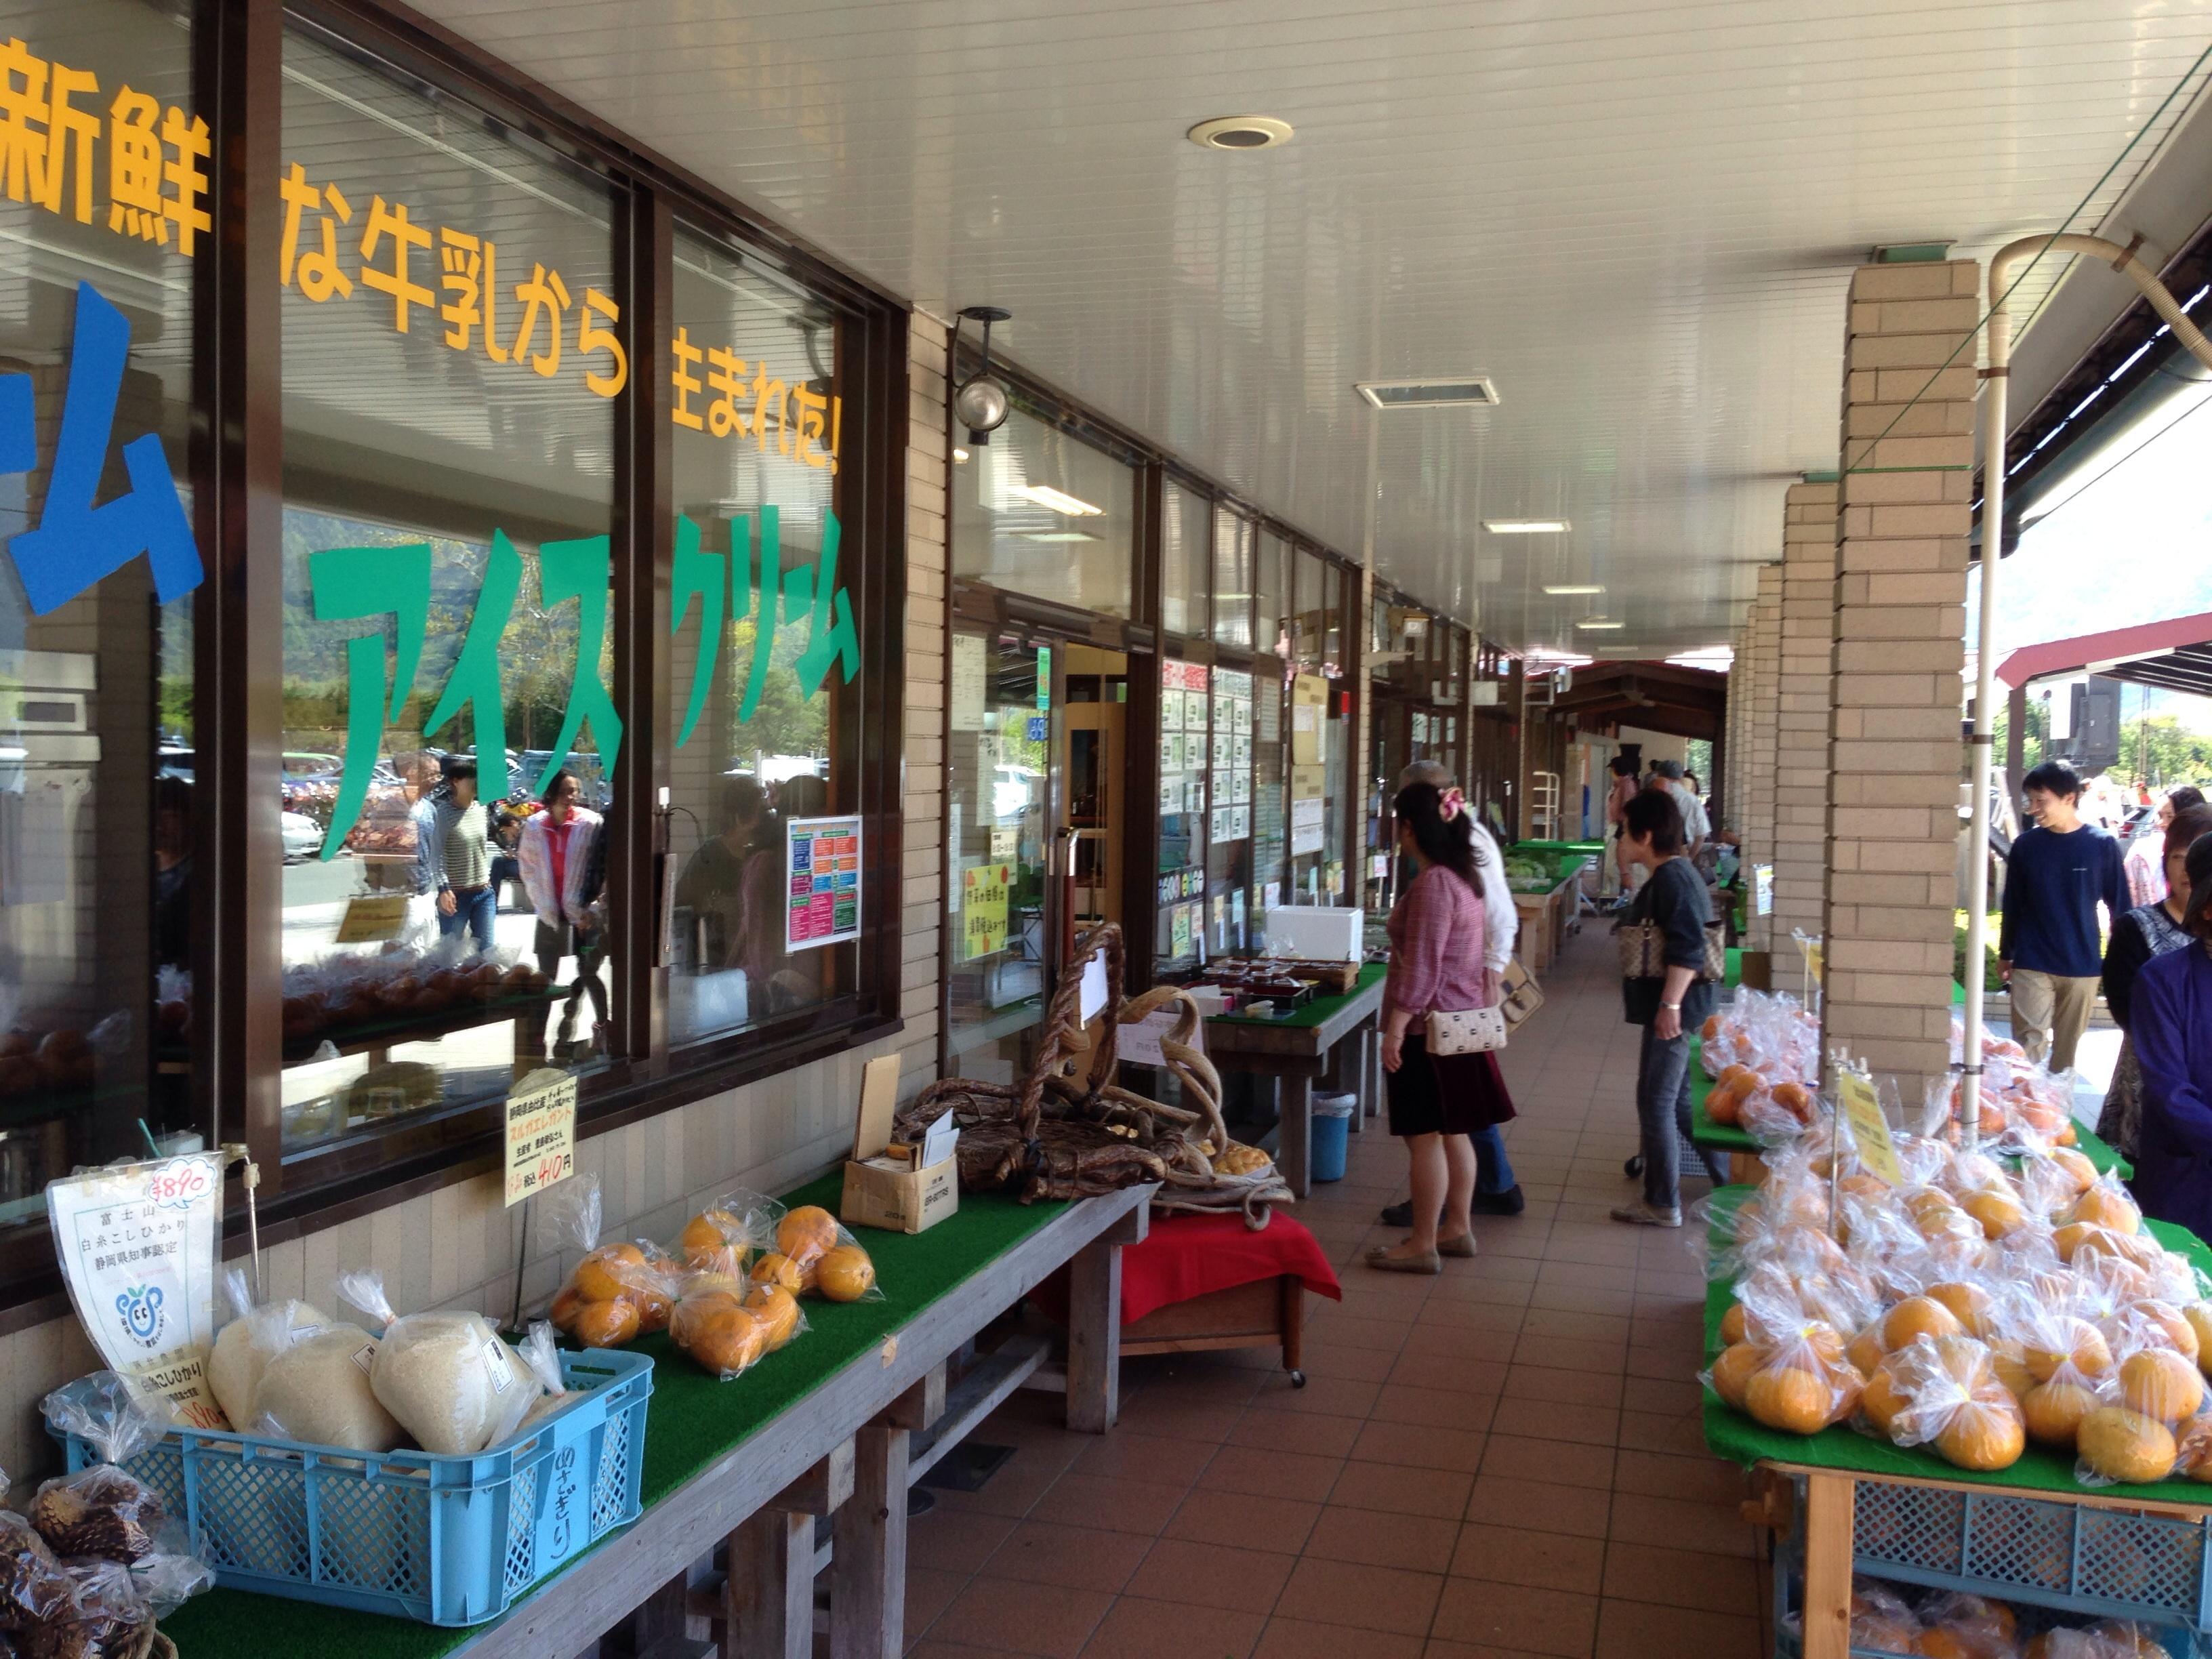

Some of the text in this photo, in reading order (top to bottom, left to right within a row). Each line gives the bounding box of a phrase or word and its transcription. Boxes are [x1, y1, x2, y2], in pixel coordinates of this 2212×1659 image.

[280, 162, 628, 398] な牛乳から
[510, 1106, 572, 1143] スルガエレガント
[94, 1241, 178, 1271] 静岡県知事認定
